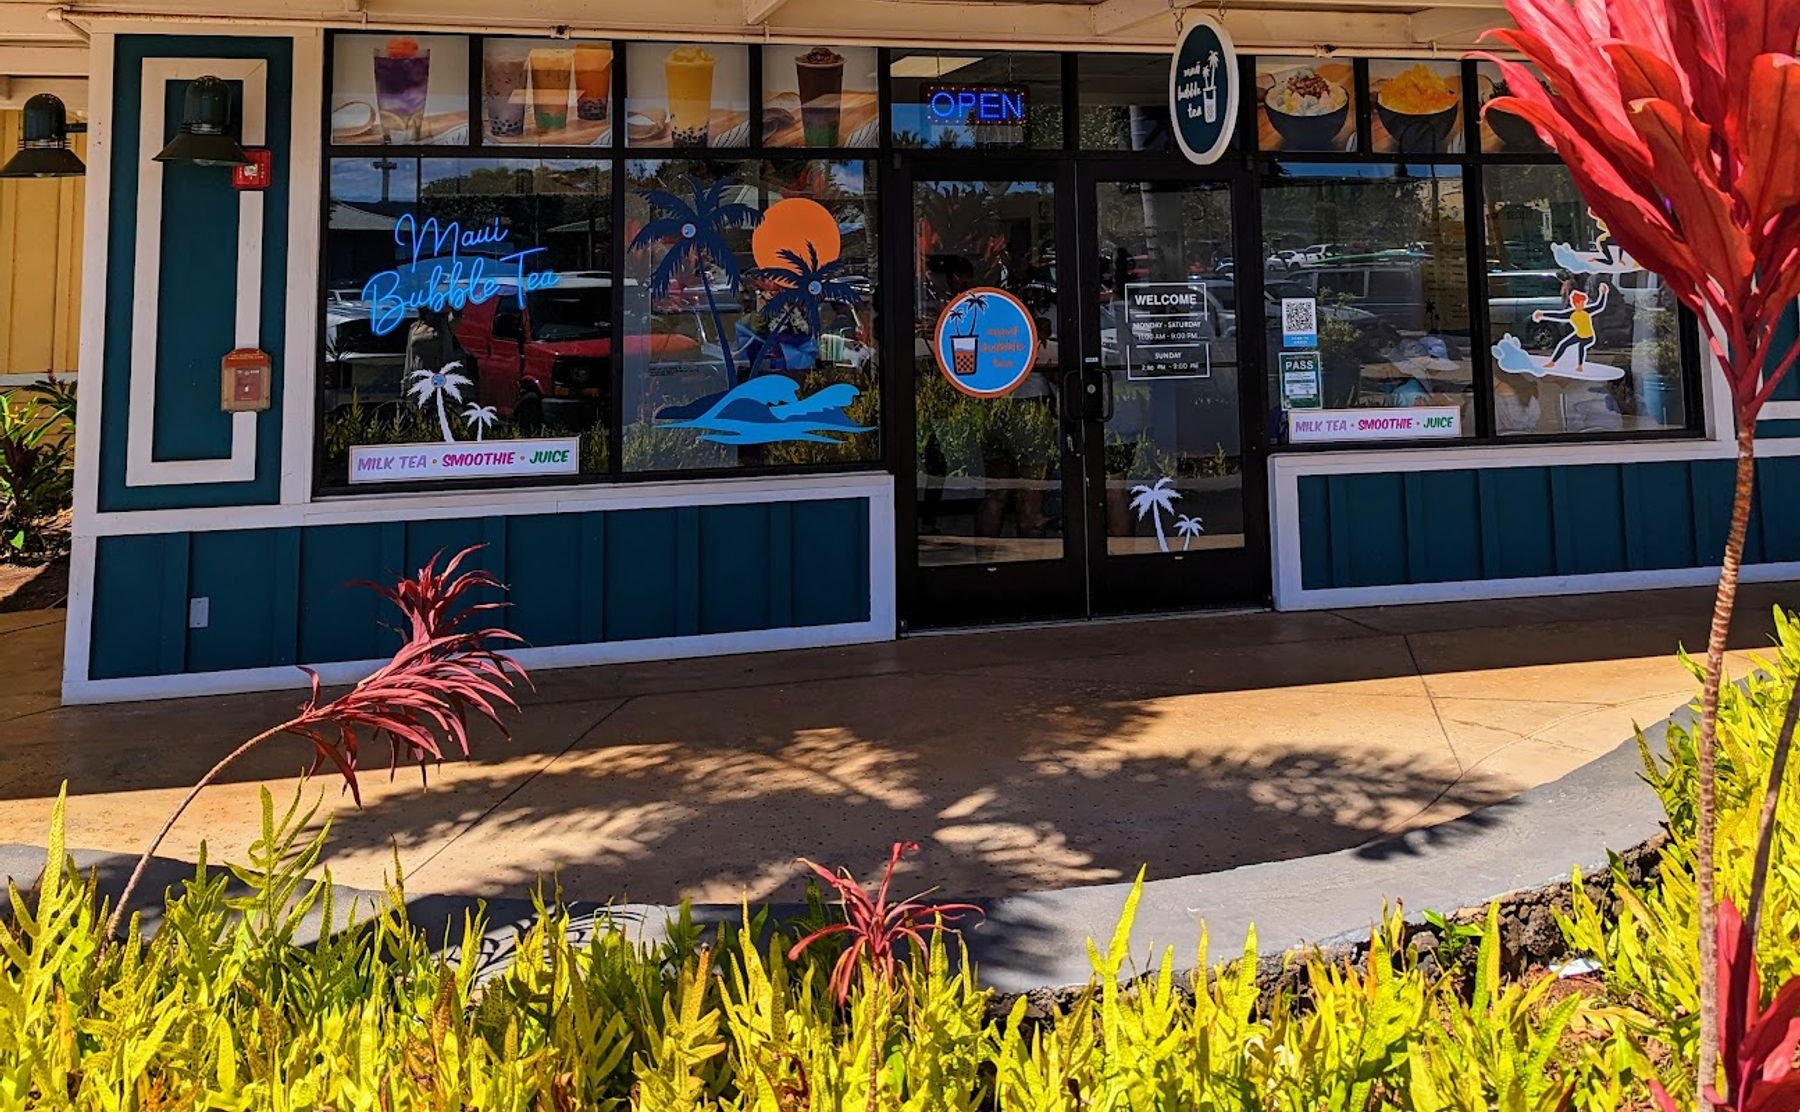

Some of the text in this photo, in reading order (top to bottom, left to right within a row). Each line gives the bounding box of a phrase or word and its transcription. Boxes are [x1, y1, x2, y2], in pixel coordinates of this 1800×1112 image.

[931, 92, 1022, 119] OPEN
[1187, 103, 1202, 118] tea
[394, 213, 509, 273] Maui
[361, 246, 561, 335] Bubble Tea
[1134, 294, 1197, 306] WELCOME
[1285, 360, 1314, 371] PASS
[1295, 416, 1454, 433] MILK TEA SMOOTHIE JUICE
[357, 449, 570, 471] MILK TEA SMOOTHIE JUICE
